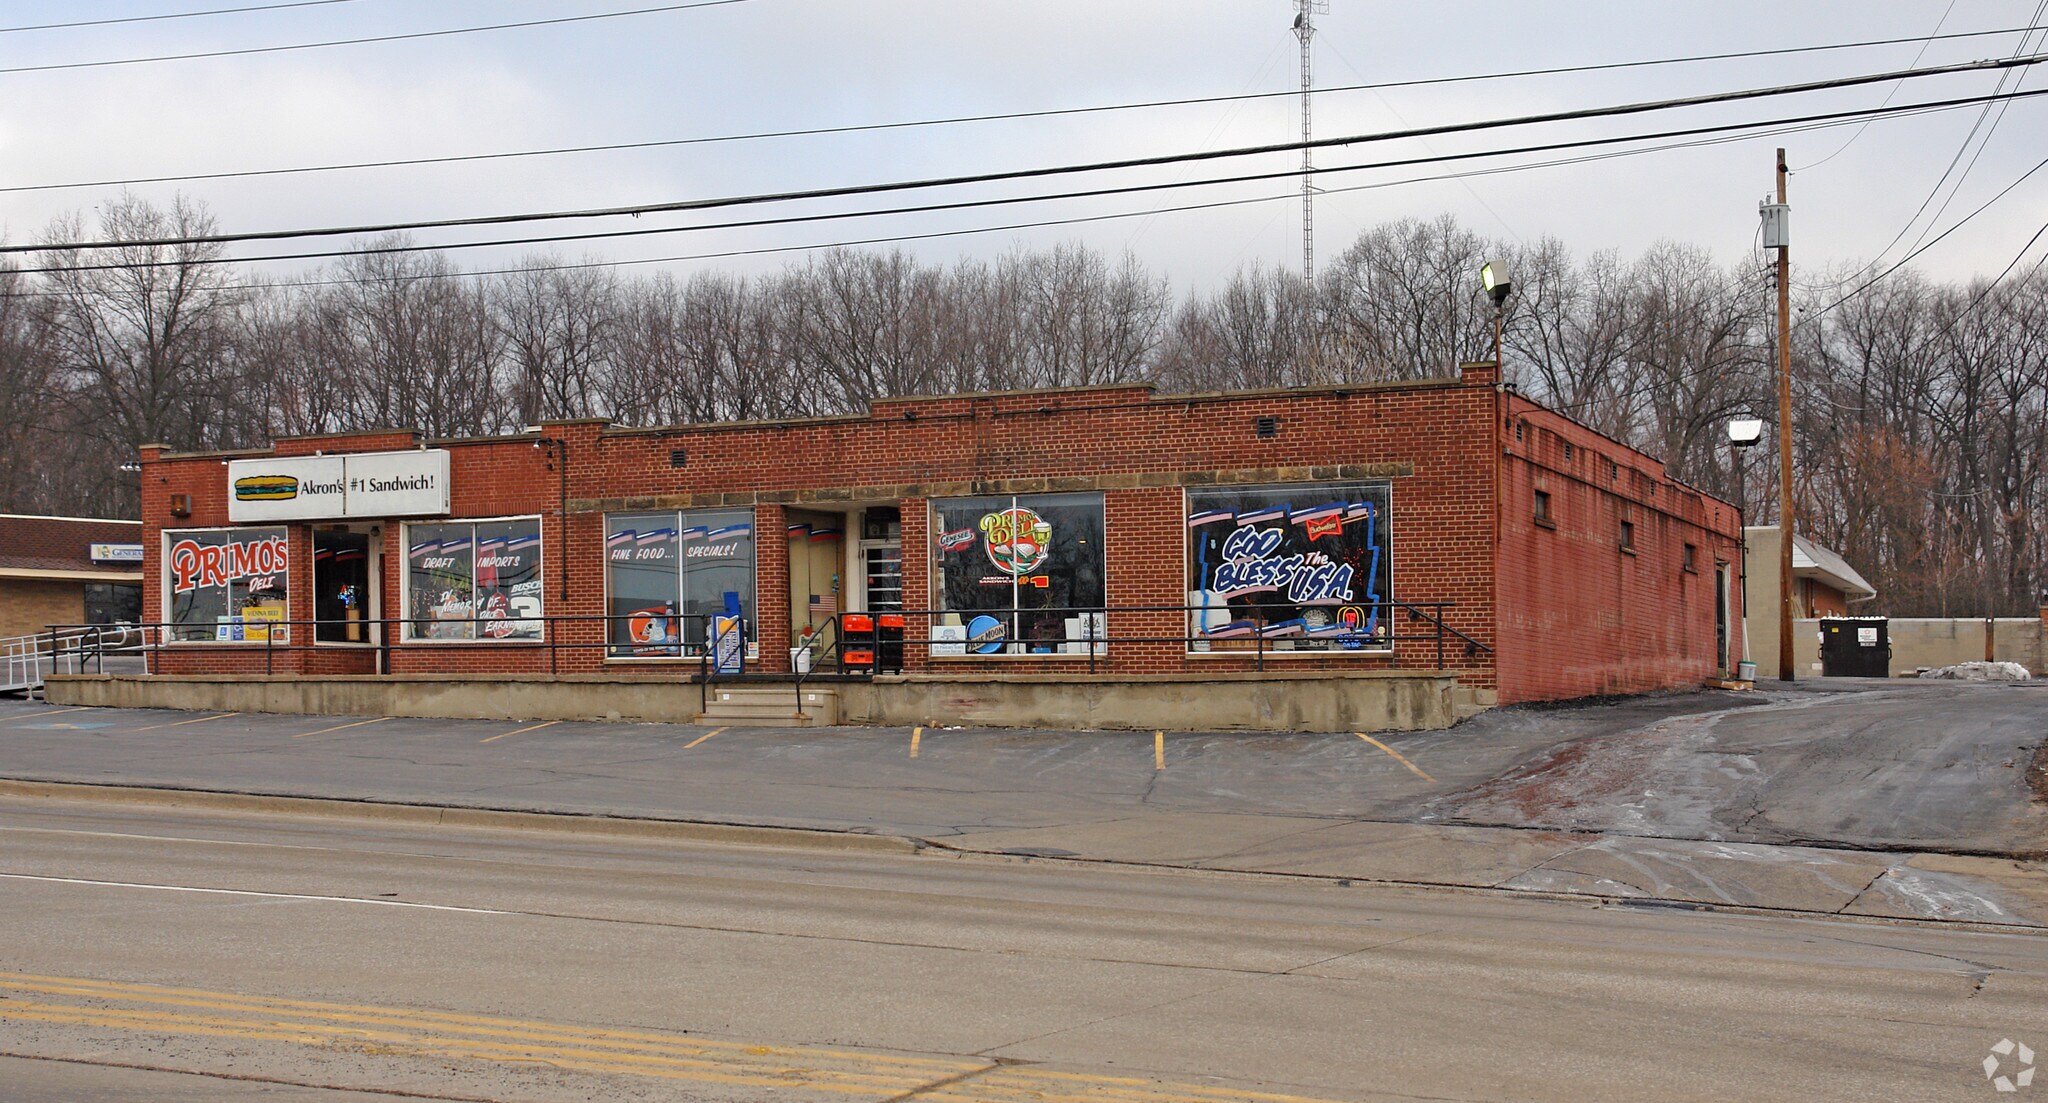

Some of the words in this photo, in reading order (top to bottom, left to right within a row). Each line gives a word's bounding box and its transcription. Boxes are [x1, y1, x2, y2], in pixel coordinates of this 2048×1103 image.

[301, 479, 344, 495] Akron's
[350, 478, 365, 493] #1
[369, 475, 434, 493] Sandwich!
[612, 549, 632, 560] FINE
[636, 547, 675, 560] FOOD...
[687, 542, 738, 558] SPECIALS!
[1222, 524, 1283, 562] GOD
[112, 548, 144, 557] GENERA
[1305, 551, 1329, 565] The
[170, 534, 288, 594] PRIMO'S
[423, 557, 456, 569] DRAFT
[477, 556, 521, 568] IMPORTS
[1213, 554, 1304, 595] BLESS
[249, 576, 276, 592] DELI
[985, 626, 1004, 640] MOON
